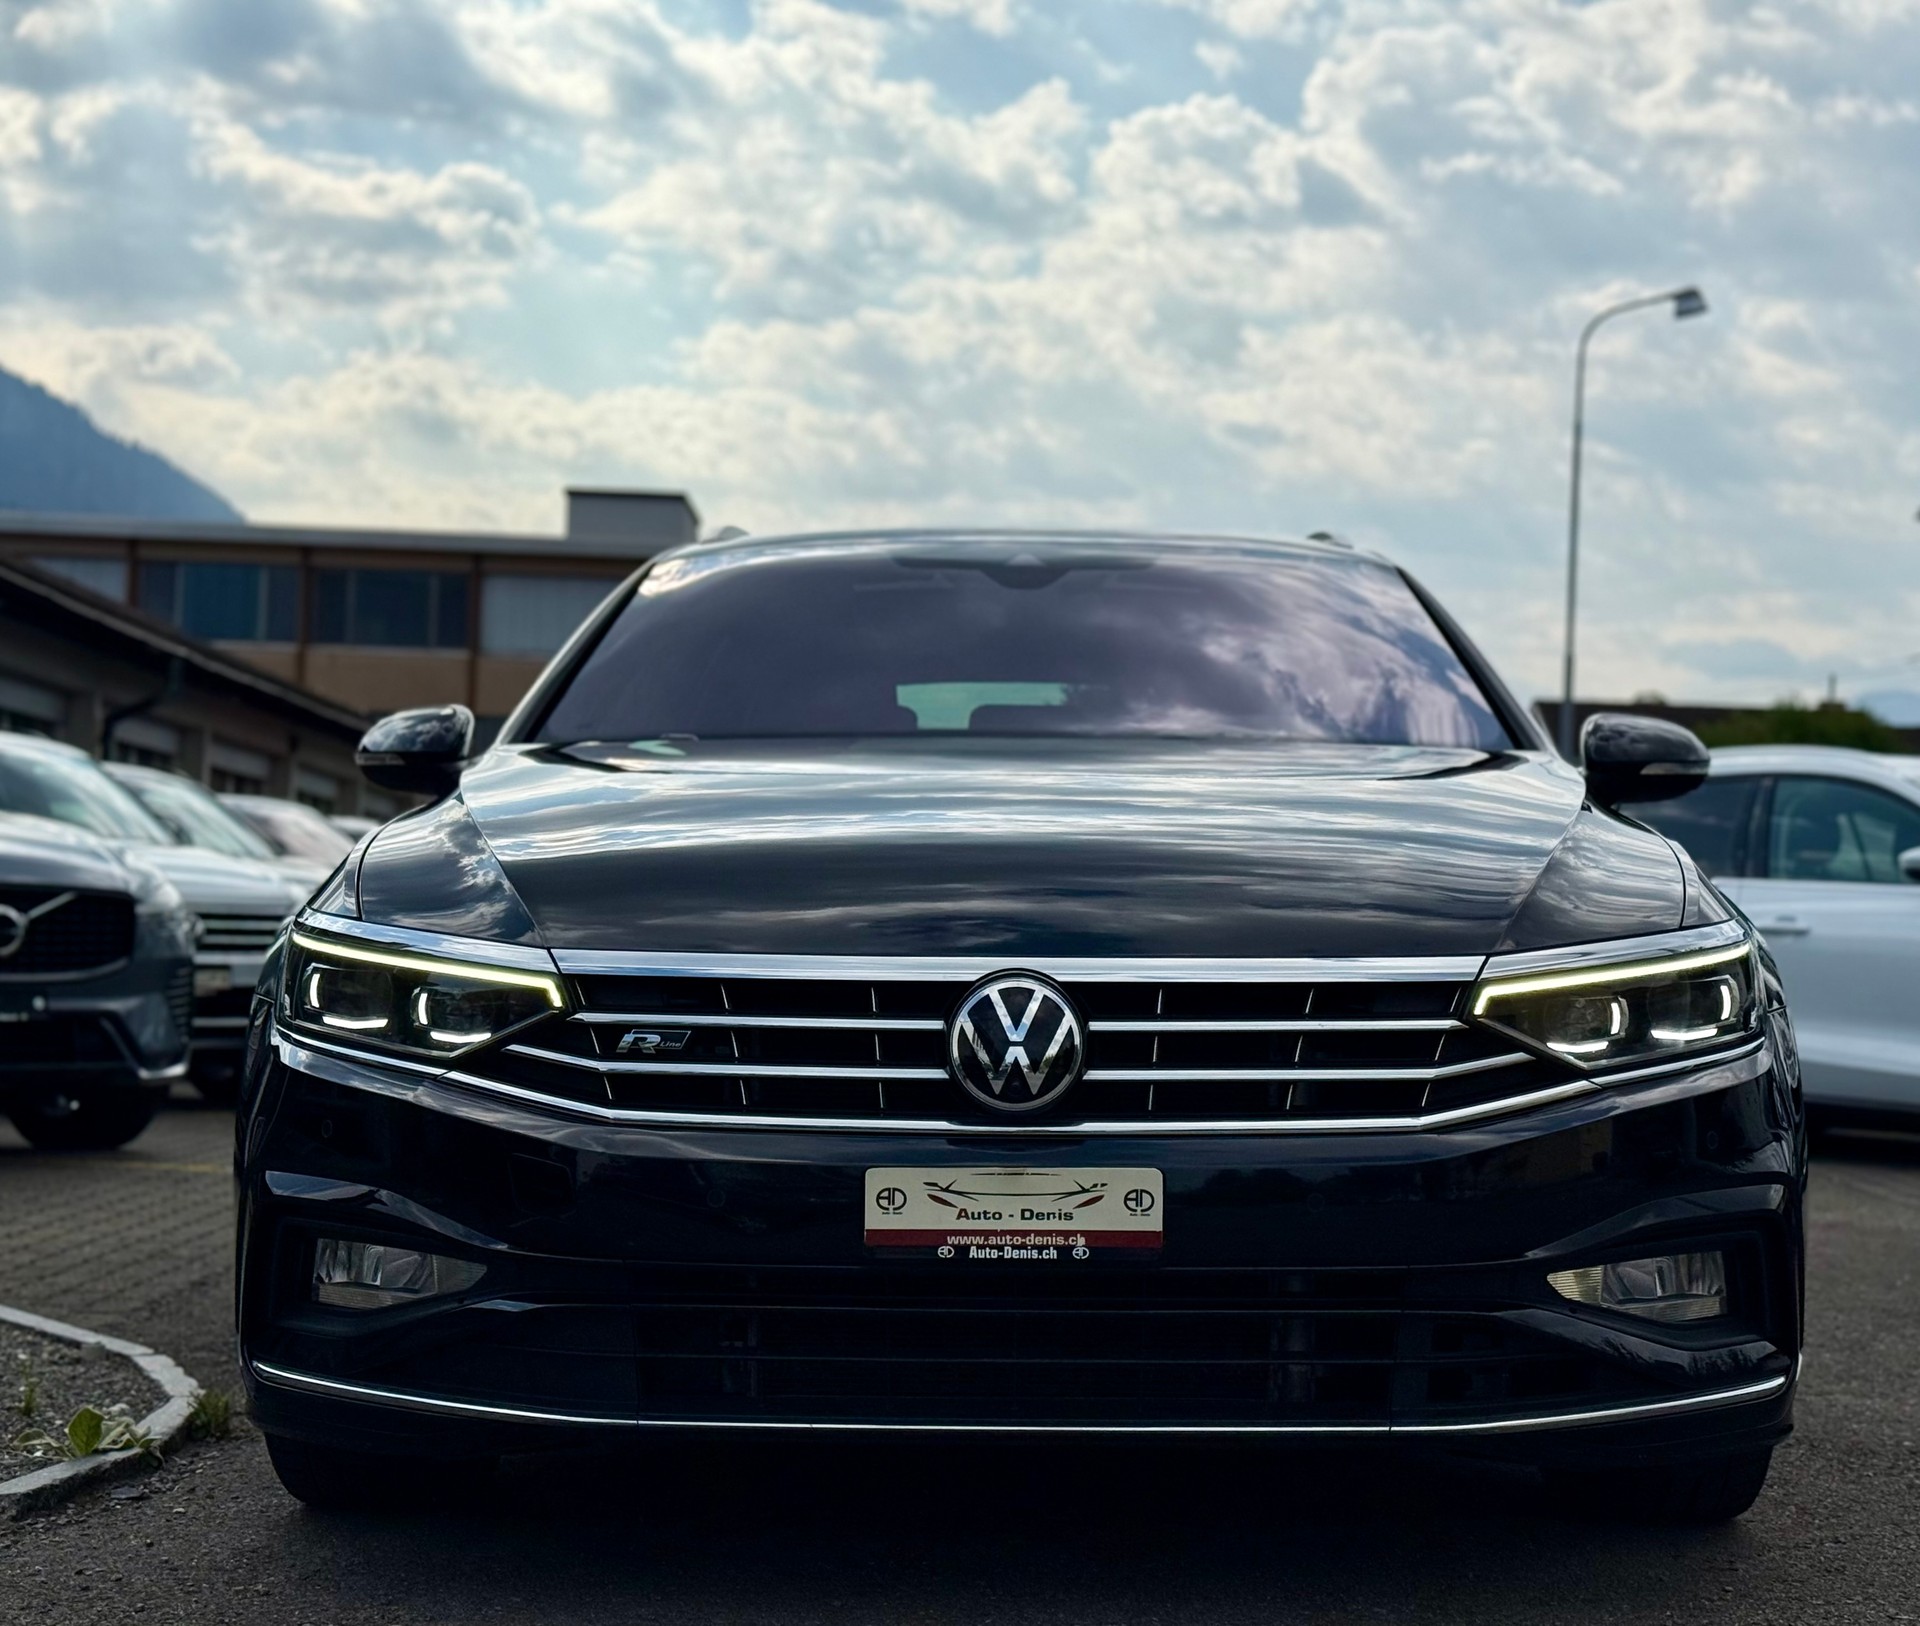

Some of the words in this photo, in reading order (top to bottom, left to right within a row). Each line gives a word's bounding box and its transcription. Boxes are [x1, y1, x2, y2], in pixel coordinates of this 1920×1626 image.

[616, 1034, 661, 1054] R
[956, 982, 1077, 1096] VW
[956, 1208, 1003, 1221] Auto
[1020, 1208, 1074, 1221] Denis
[947, 1233, 1086, 1247] www.auto-denis.ch
[969, 1245, 1057, 1259] Auto-Denis.ch
